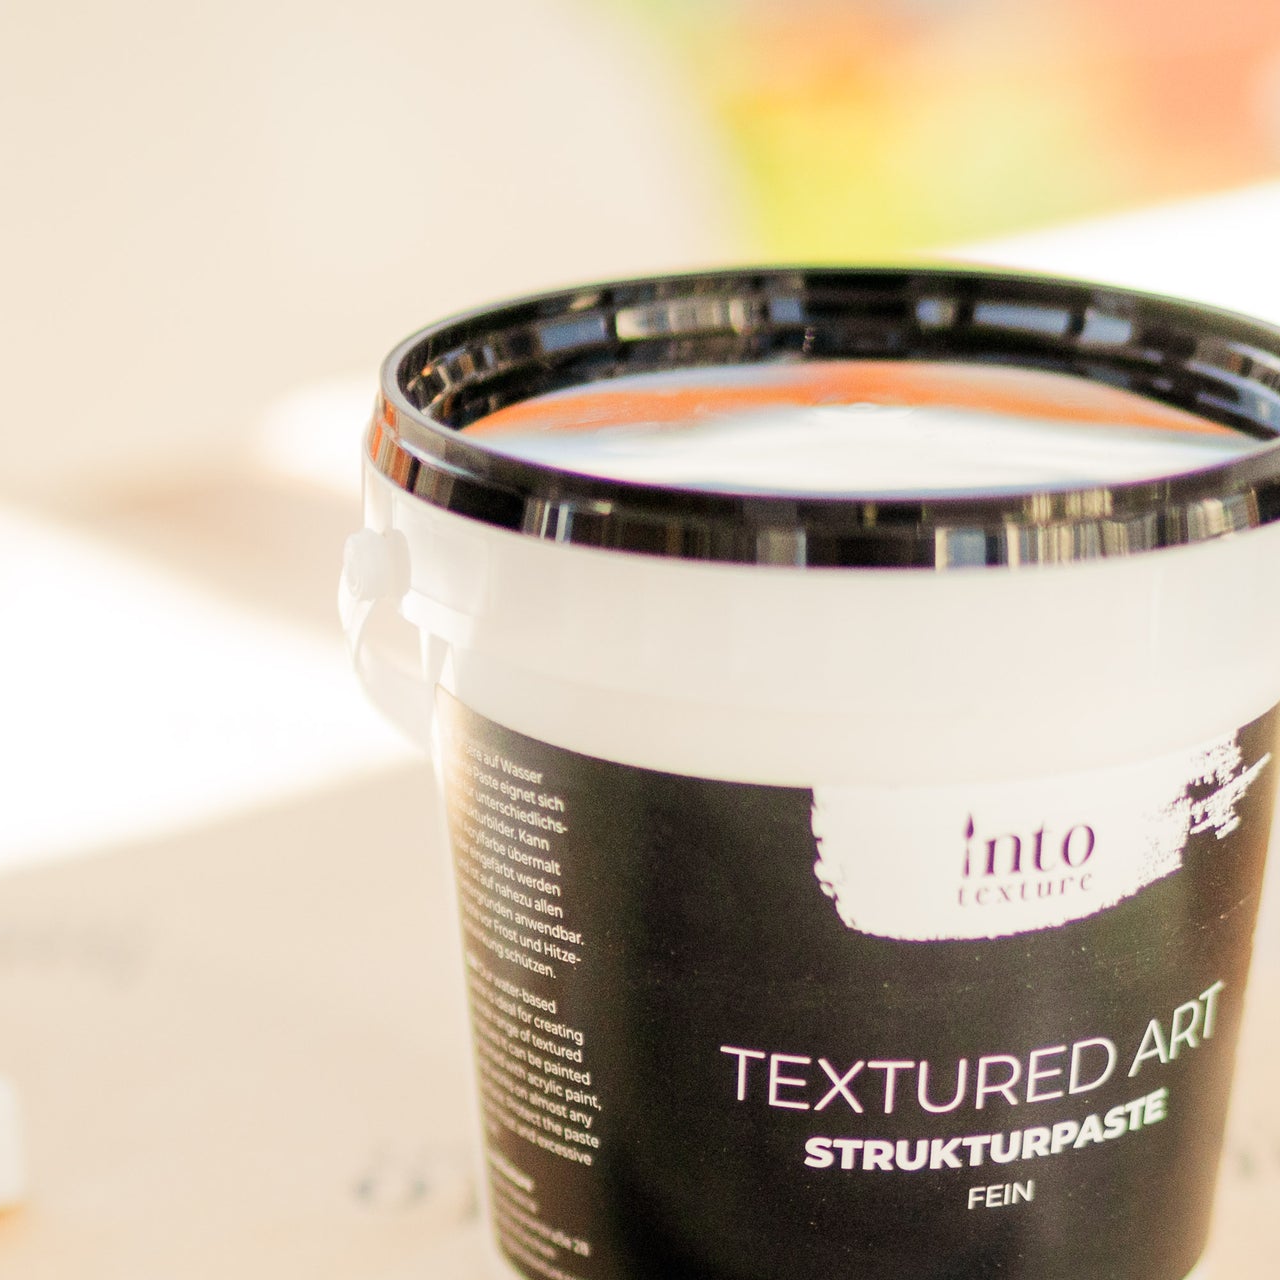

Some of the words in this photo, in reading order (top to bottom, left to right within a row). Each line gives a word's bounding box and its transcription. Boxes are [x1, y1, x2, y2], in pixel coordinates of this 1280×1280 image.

[483, 754, 500, 770] auf
[500, 758, 544, 785] Wasser
[472, 766, 499, 790] Paste
[500, 780, 536, 805] eignet
[537, 793, 567, 813] sich
[475, 789, 569, 835] unterschiedlichs-
[518, 828, 551, 852] Kann
[961, 810, 1099, 879] into
[506, 844, 562, 877] übermalt
[479, 874, 495, 890] auf
[495, 882, 533, 909] nahezu
[534, 898, 565, 920] allen
[516, 872, 562, 898] werden
[955, 869, 1095, 908] texture
[492, 917, 519, 944] Frost
[519, 934, 542, 954] und
[543, 940, 582, 966] Hitze-
[514, 911, 586, 946] anwendbar.
[504, 946, 558, 980] schützen.
[493, 975, 557, 1015] water-based
[516, 1005, 532, 1025] for
[533, 1015, 585, 1047] creating
[520, 1028, 532, 1044] of
[531, 1034, 584, 1064] textured
[719, 1035, 1119, 1116] TEXTURED
[1126, 980, 1226, 1079] ART
[527, 1050, 543, 1069] be
[543, 1060, 592, 1087] painted
[526, 1071, 564, 1098] acrylic
[564, 1088, 602, 1112] paint,
[528, 1092, 568, 1120] almost
[568, 1109, 593, 1130] any
[803, 1087, 1170, 1172] STRUKTURPASTE
[536, 1135, 594, 1167] excessive
[542, 1117, 563, 1137] the
[563, 1127, 601, 1150] paste
[966, 1179, 1037, 1211] FEIN
